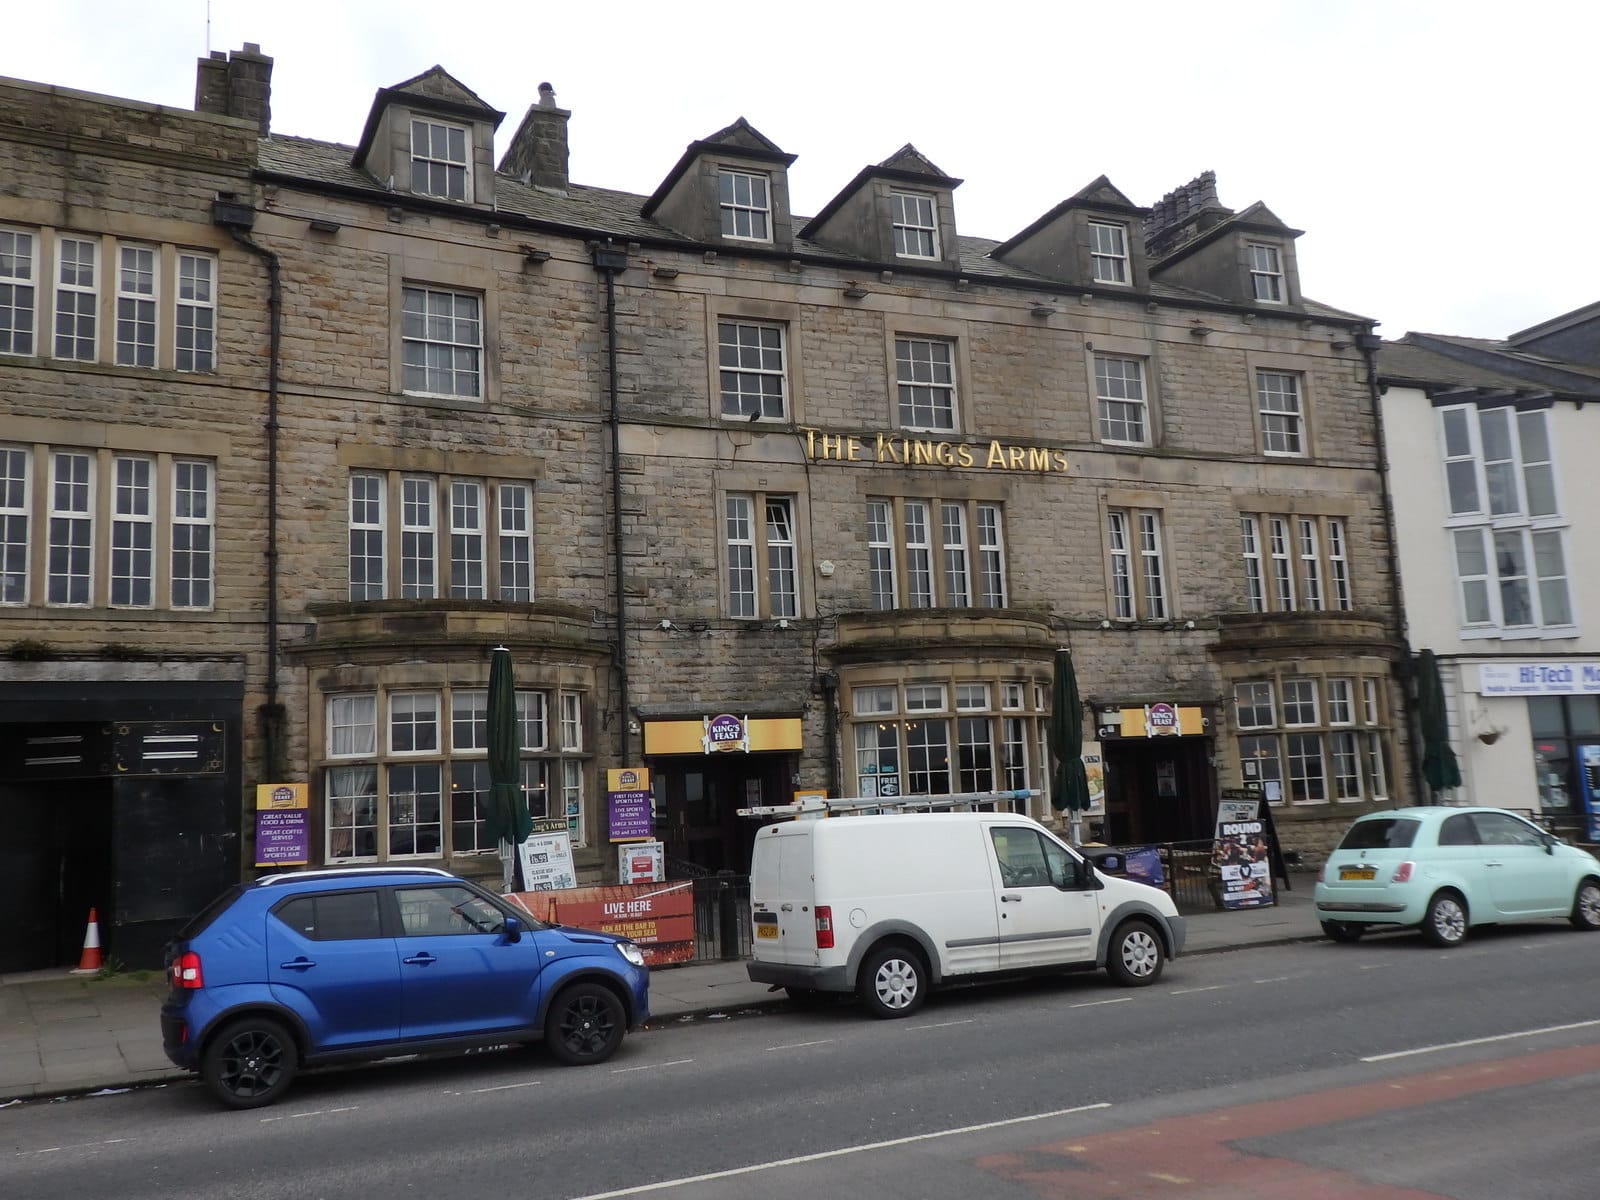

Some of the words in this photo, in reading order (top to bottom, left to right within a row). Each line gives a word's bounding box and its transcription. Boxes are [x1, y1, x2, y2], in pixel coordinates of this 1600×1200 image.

[800, 427, 861, 461] THE
[877, 432, 974, 468] KINGS
[986, 440, 1068, 473] ARMS
[1519, 665, 1573, 683] Hi-Tech
[712, 724, 740, 733] KING'S
[715, 732, 738, 740] FEAST
[881, 777, 897, 785] FREE
[532, 822, 550, 832] ing's
[550, 820, 566, 829] Arms
[1223, 823, 1262, 835] ROUND
[604, 902, 625, 915] LIVE
[627, 900, 652, 913] HERE
[648, 921, 655, 929] TO
[627, 930, 643, 938] YOUR
[644, 929, 657, 937] SEAT
